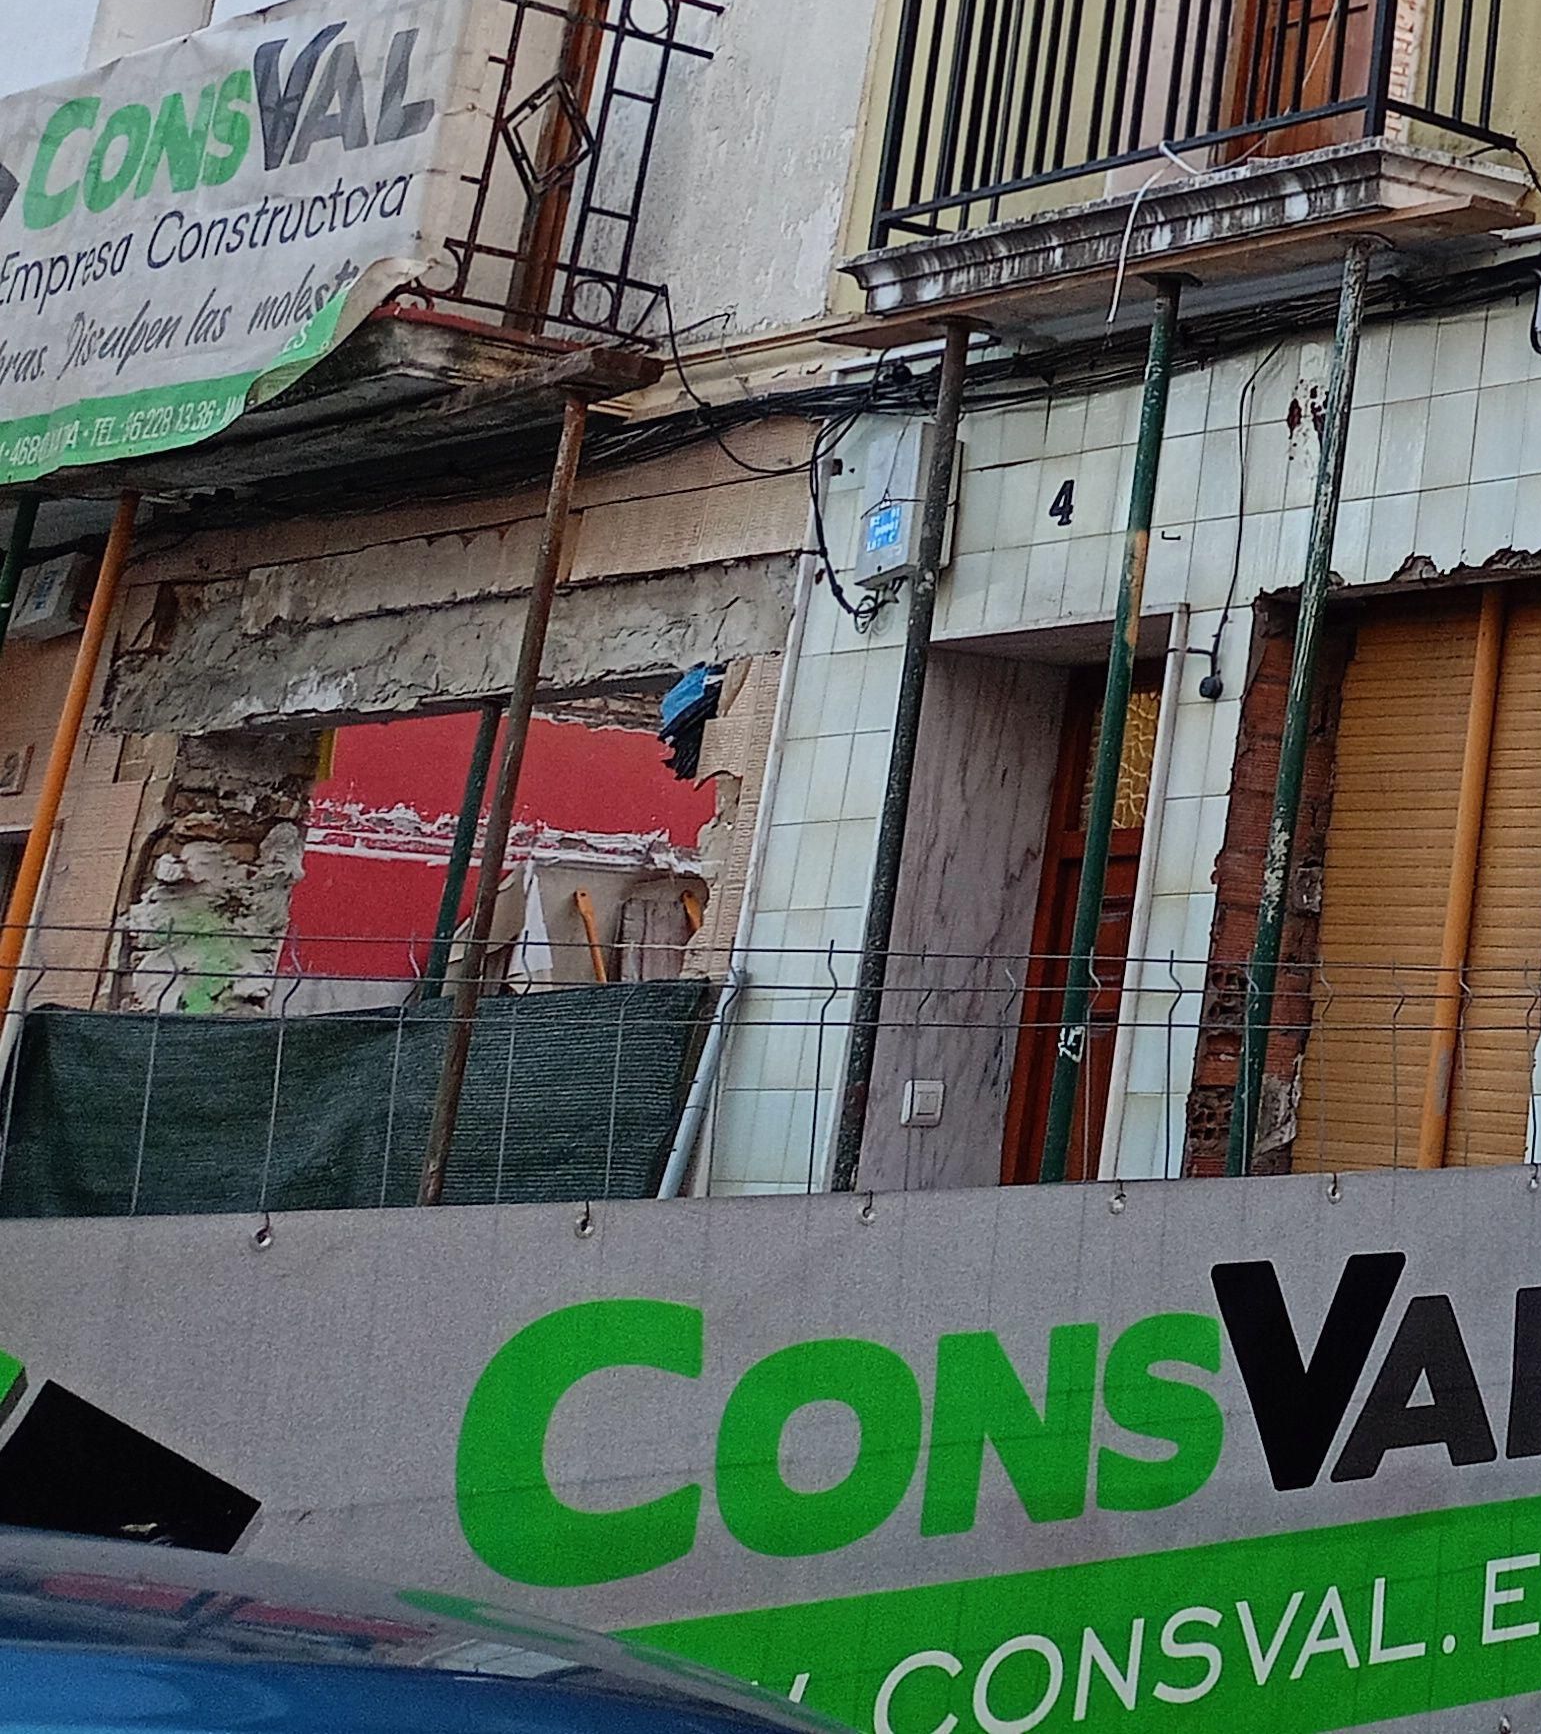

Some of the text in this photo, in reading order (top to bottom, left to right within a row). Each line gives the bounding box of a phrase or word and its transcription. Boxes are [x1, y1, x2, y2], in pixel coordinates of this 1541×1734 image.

[0, 174, 413, 315] Empresa Constructora
[185, 288, 232, 347] las
[1050, 479, 1075, 526] 4
